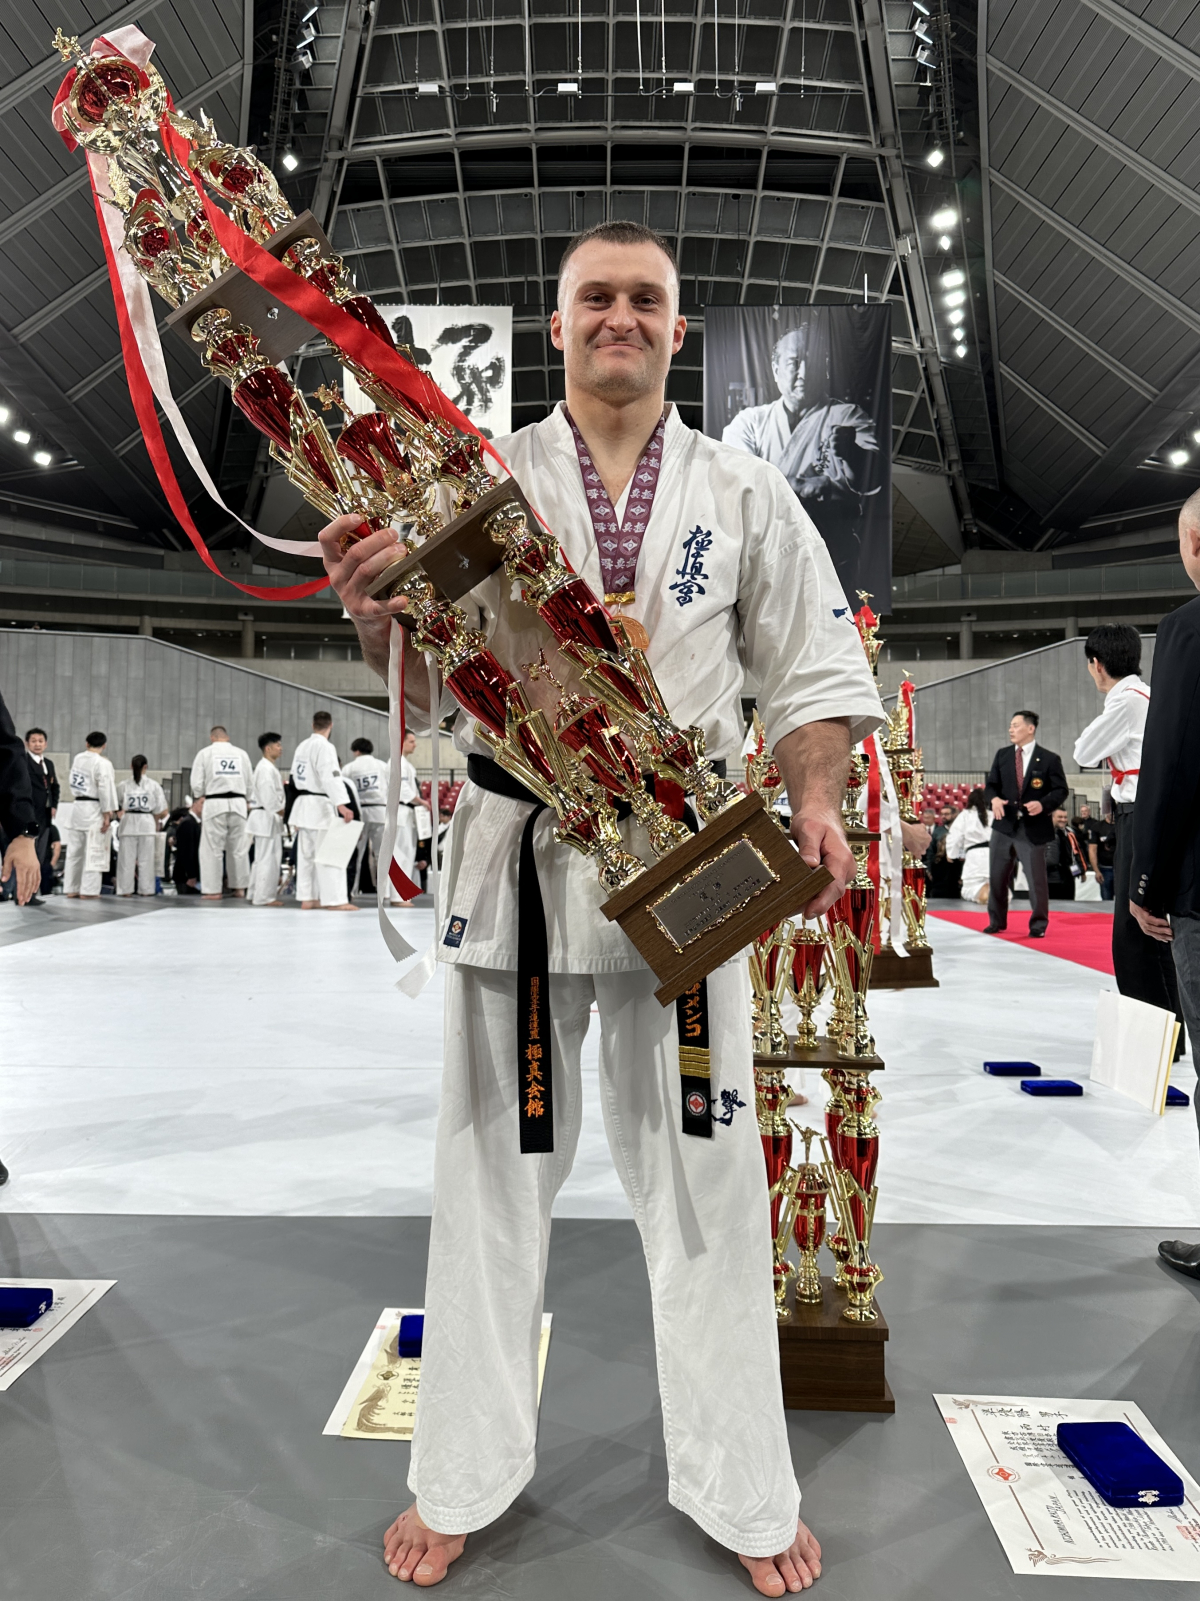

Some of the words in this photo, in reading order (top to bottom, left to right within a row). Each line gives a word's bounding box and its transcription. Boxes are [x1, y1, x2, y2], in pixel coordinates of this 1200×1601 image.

[220, 760, 236, 770] 94
[356, 775, 378, 788] 157
[129, 796, 149, 808] 219
[525, 1043, 545, 1118] 極真会館
